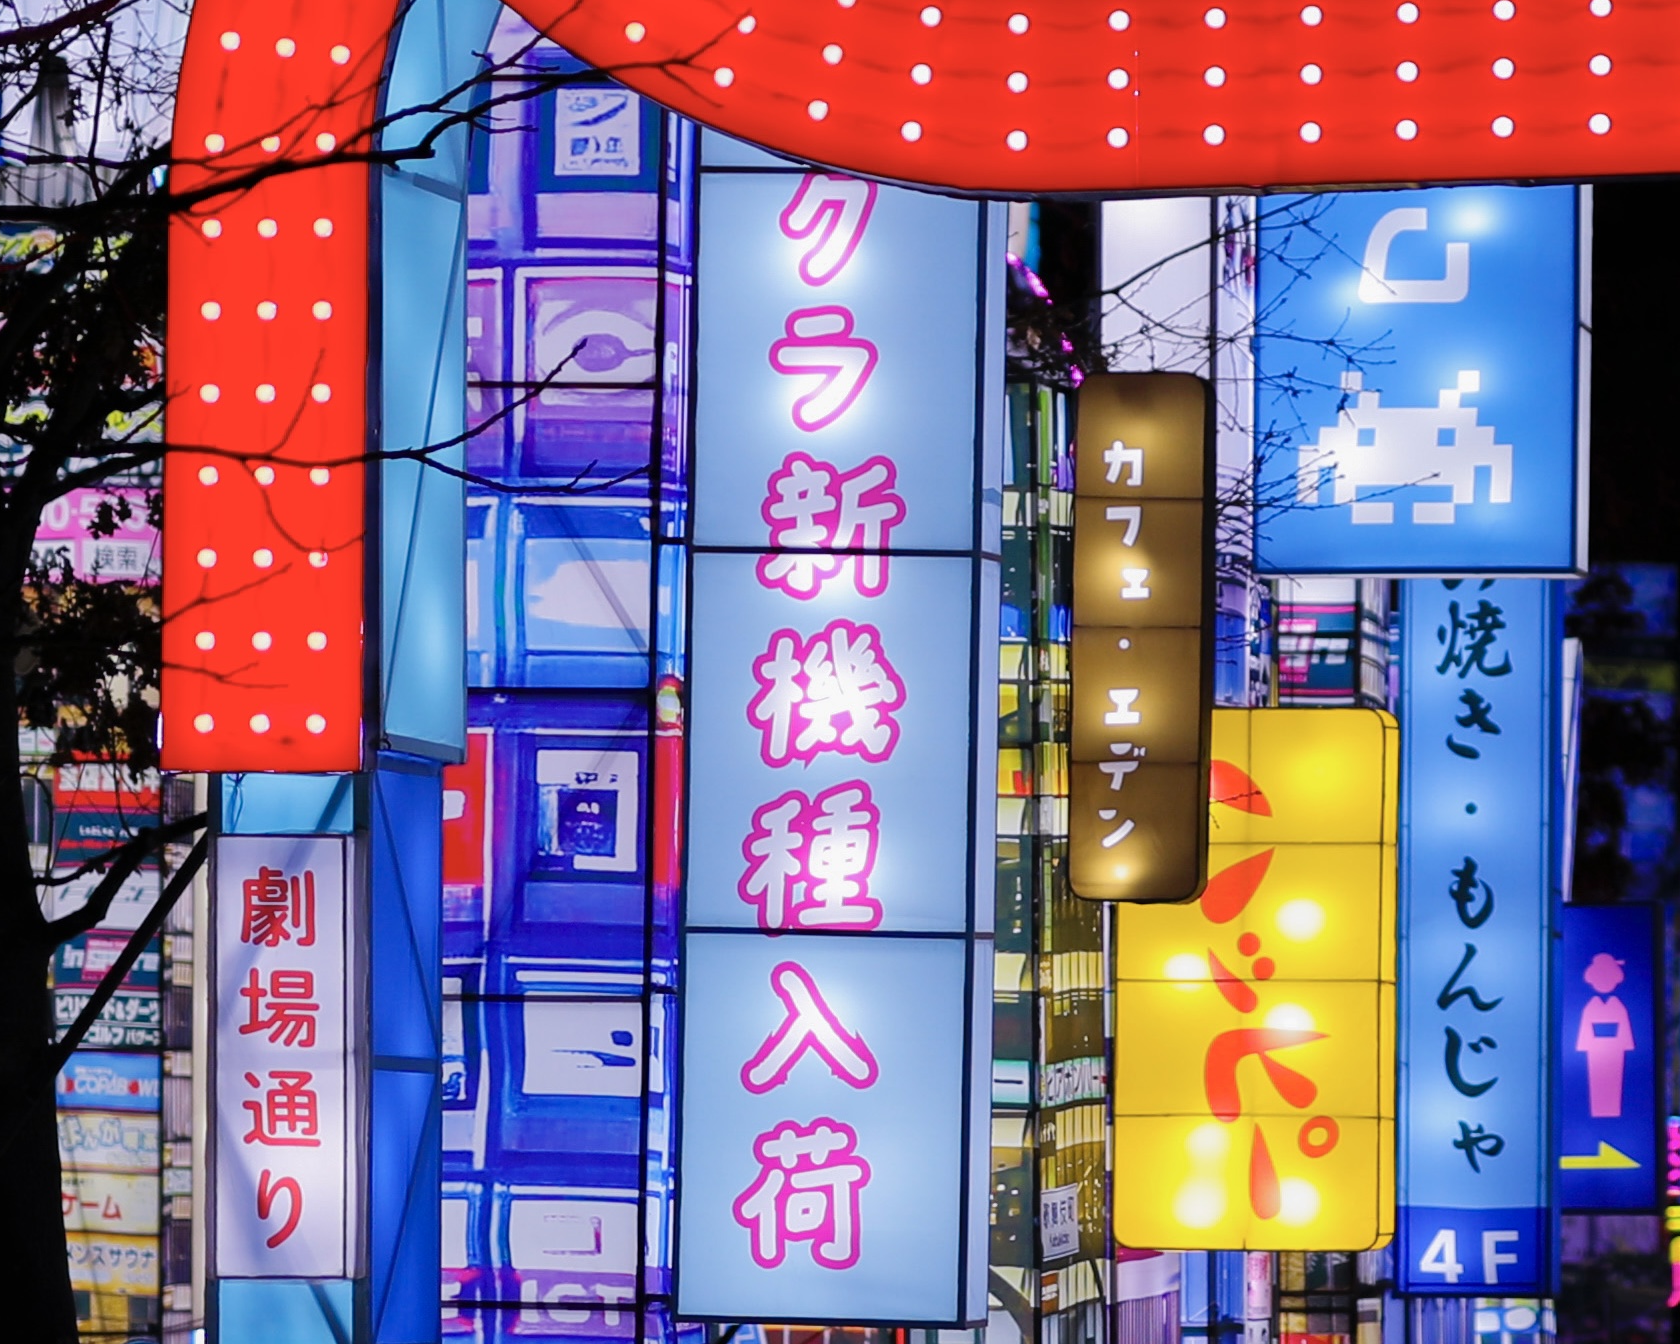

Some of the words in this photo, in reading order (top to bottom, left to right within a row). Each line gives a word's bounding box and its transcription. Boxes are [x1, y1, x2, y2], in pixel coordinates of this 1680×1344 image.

[1097, 440, 1152, 848] カフェ・エデン
[238, 864, 323, 1250] 劇場通り
[1434, 578, 1512, 1174] 焼き・もんじゃ
[1418, 1228, 1521, 1285] 4F
